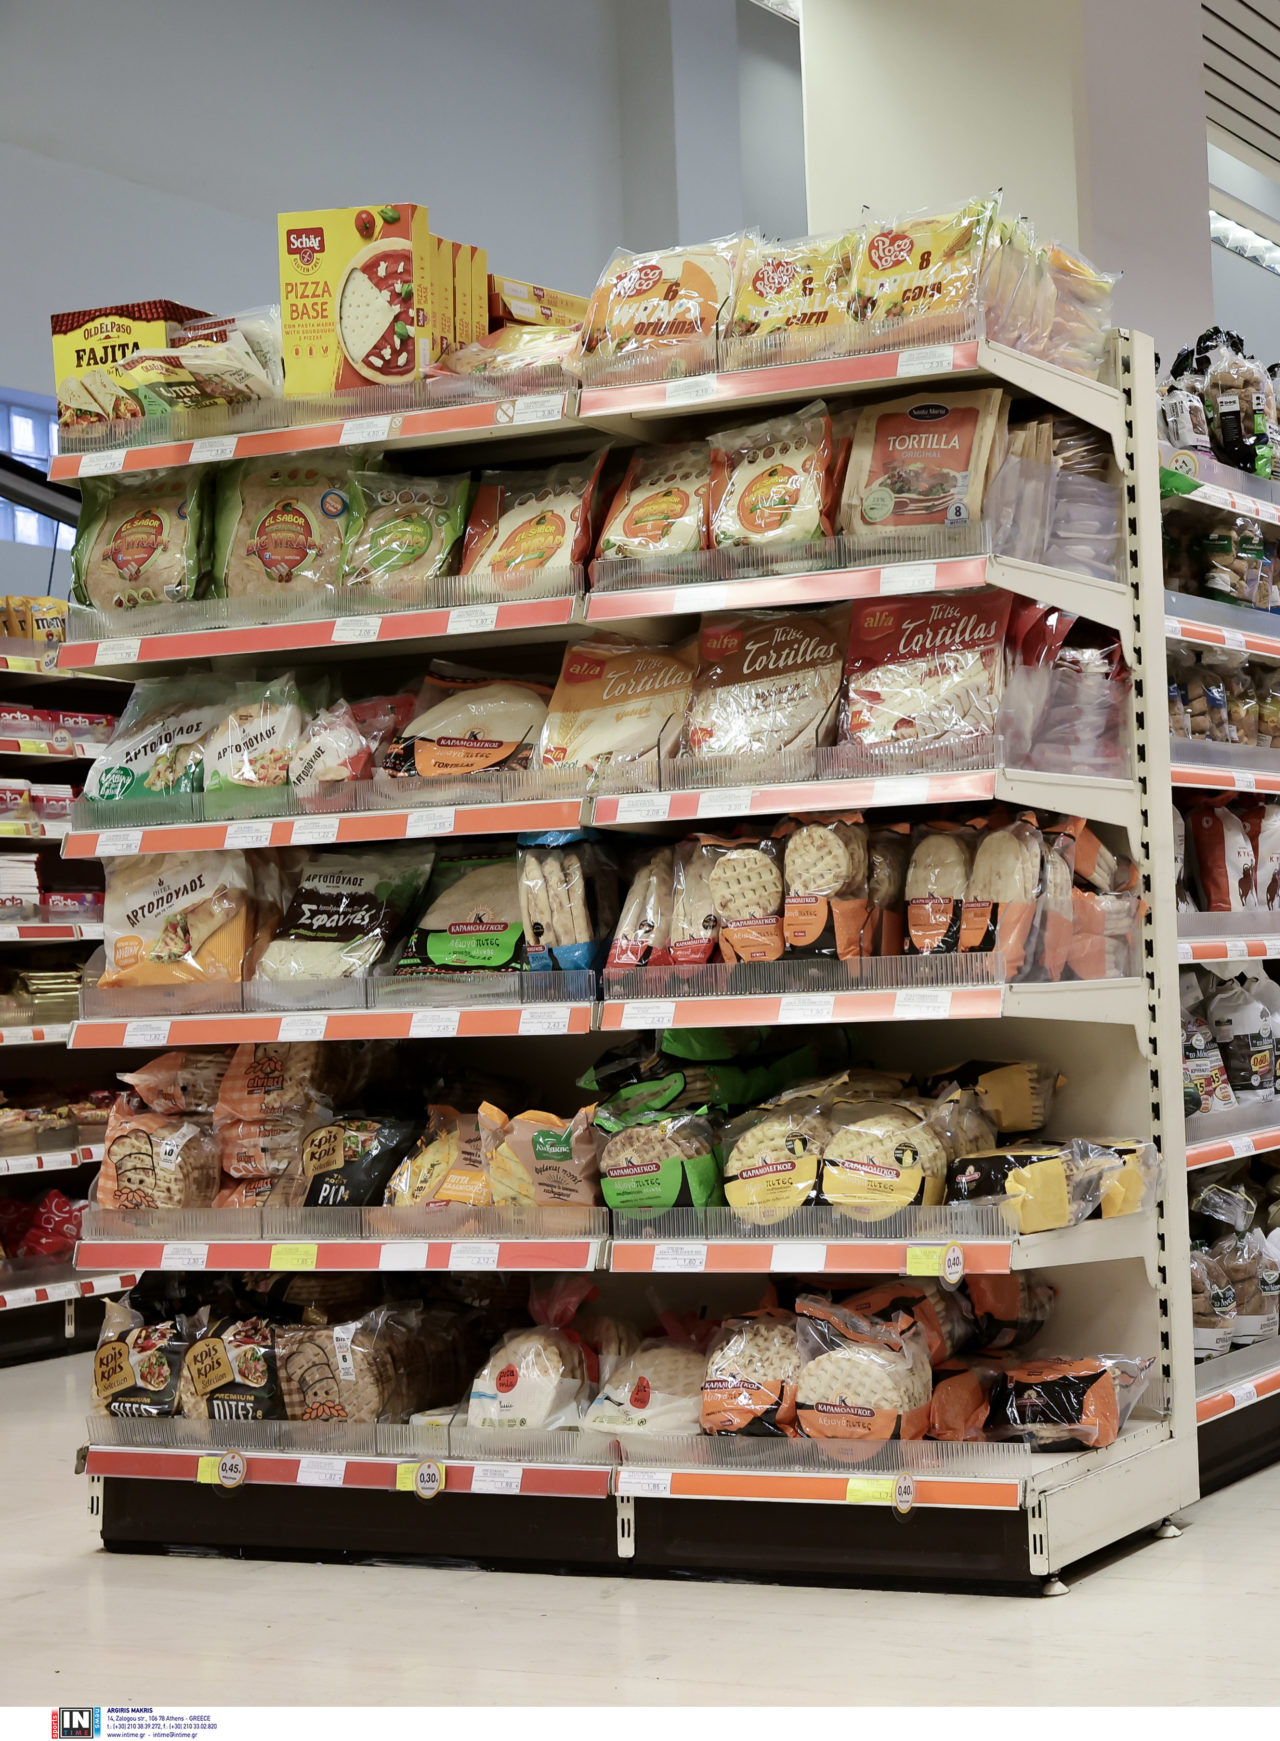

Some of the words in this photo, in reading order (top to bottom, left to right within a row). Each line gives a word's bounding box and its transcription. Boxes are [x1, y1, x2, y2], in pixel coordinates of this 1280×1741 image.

[290, 232, 322, 251] Schär
[873, 234, 912, 258] Poco
[871, 250, 909, 270] Loco
[919, 251, 931, 270] 8
[285, 280, 332, 301] PIZZA
[664, 281, 679, 301] 6
[802, 277, 814, 297] 8
[289, 302, 329, 321] BASE
[785, 310, 828, 327] corn
[634, 316, 705, 337] original
[75, 341, 141, 368] FAJITA
[887, 433, 961, 451] TORTILLA
[902, 451, 942, 459] ORIGINAL
[955, 505, 962, 517] 8
[265, 516, 275, 526] EL
[276, 514, 305, 527] SABOR
[864, 610, 894, 628] alfa
[899, 615, 997, 654] Tortillas
[742, 637, 837, 675] Tortillas
[569, 662, 601, 676] alfa
[602, 667, 695, 701] Tortillas
[217, 725, 277, 761] ΑΡΤΟΠΟΥΛΟΣ
[305, 873, 364, 888] ΑΡΤΟΠΟΥΛΟΣ
[126, 873, 206, 928] ΑΡΤΟΠΟΥΛΟΣ
[451, 922, 506, 933] ΚΑΡΑΜΟΛΕΓΚΟΣ
[163, 1148, 174, 1157] 10
[608, 1162, 658, 1178] ΚΑΡΑΜΟΛΕΓΚΟΣ
[742, 1162, 793, 1179] ΚΑΡΑΜΟΛΕΓΚΟΣ
[342, 1354, 348, 1363] 6
[213, 1393, 255, 1402] PREMIUM
[818, 1404, 873, 1417] ΚΑΡΑΜΟΛΕΓΚΟΣ
